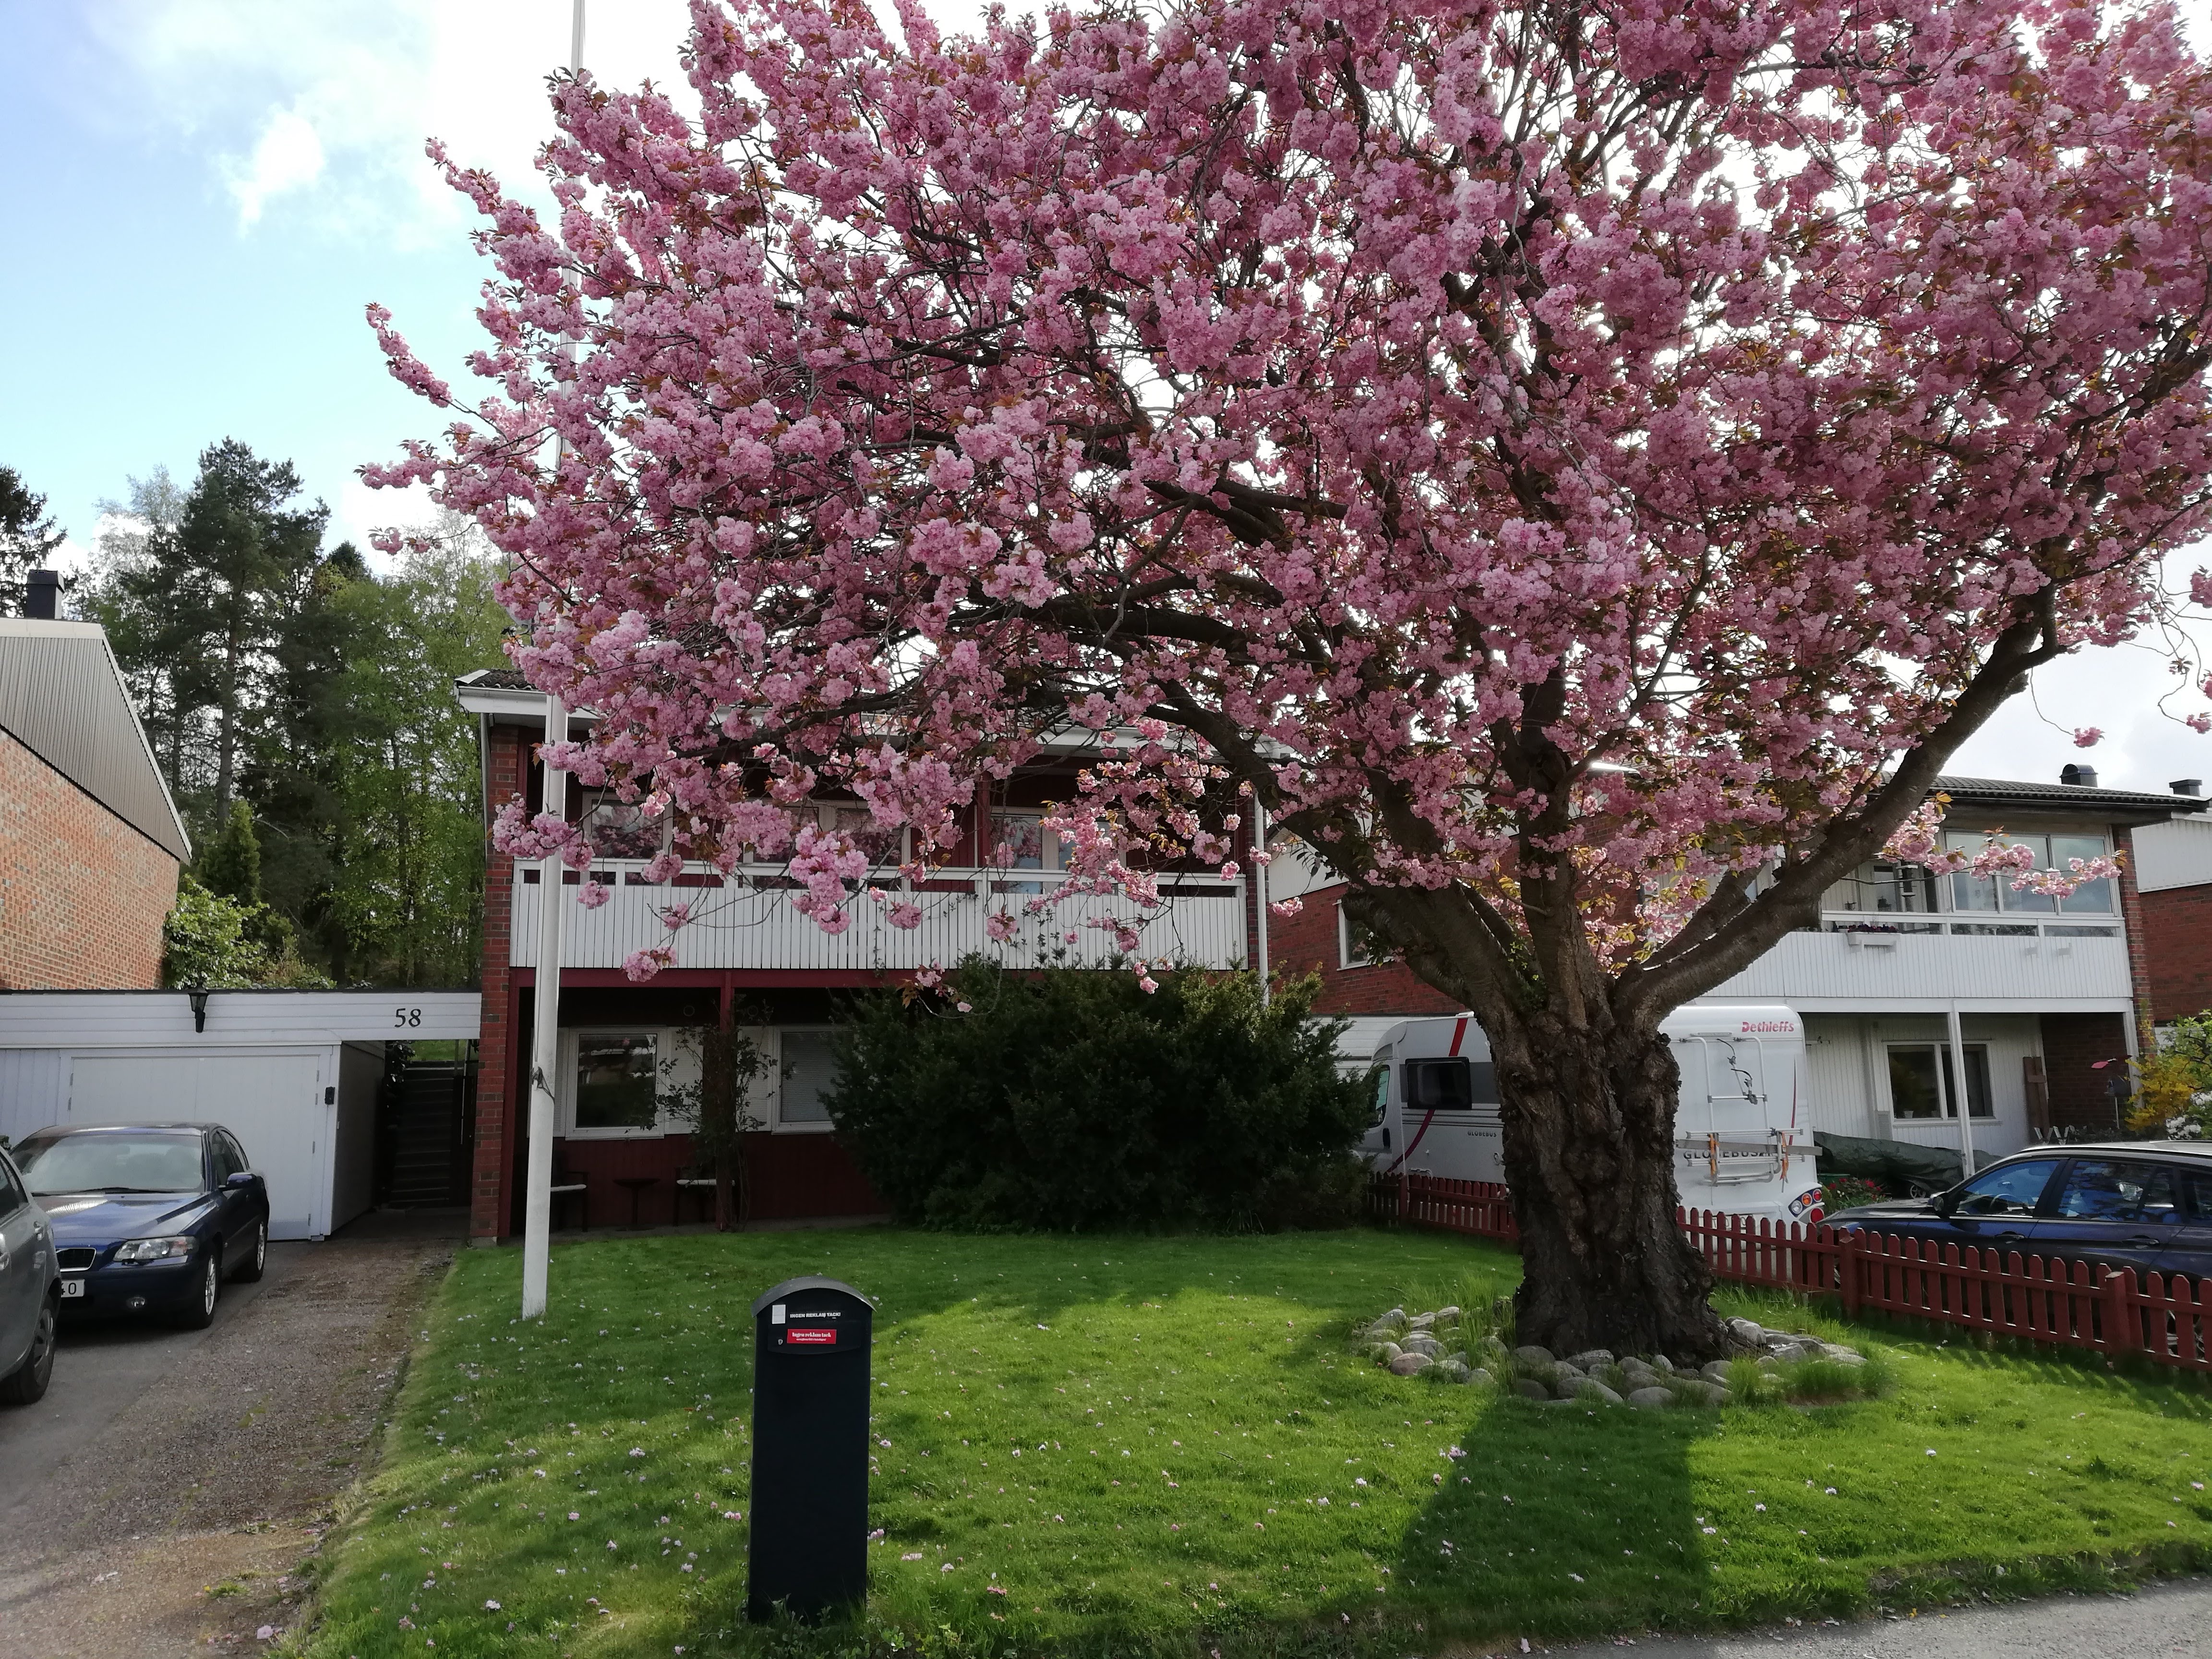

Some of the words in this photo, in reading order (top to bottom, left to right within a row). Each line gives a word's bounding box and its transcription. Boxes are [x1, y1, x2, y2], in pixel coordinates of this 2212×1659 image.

[394, 1008, 421, 1028] 58
[1742, 1021, 1794, 1033] Dethleffs
[1683, 1150, 1758, 1160] GLOEBUS
